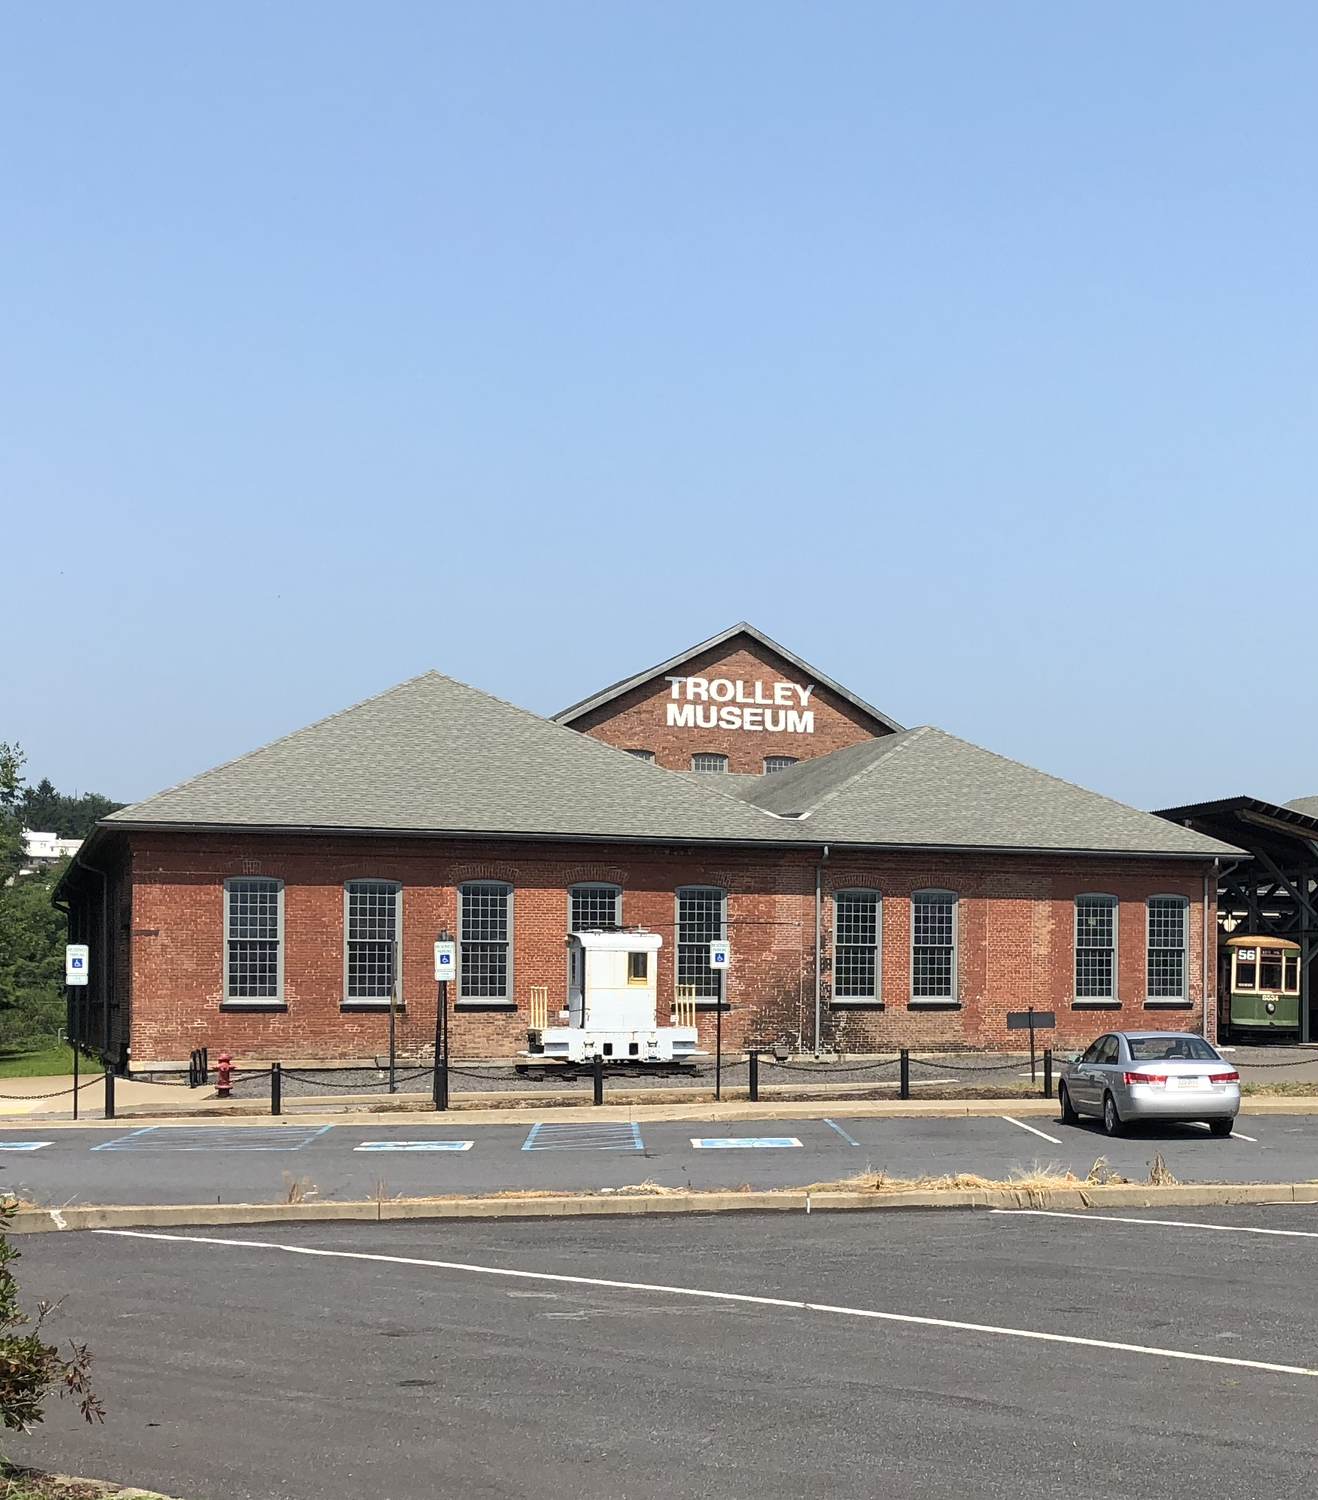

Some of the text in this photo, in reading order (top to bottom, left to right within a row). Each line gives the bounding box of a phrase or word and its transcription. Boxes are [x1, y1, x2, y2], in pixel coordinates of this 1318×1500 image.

[665, 676, 815, 707] TROLLEY
[666, 703, 815, 733] MUSEUM
[1238, 949, 1255, 960] 56
